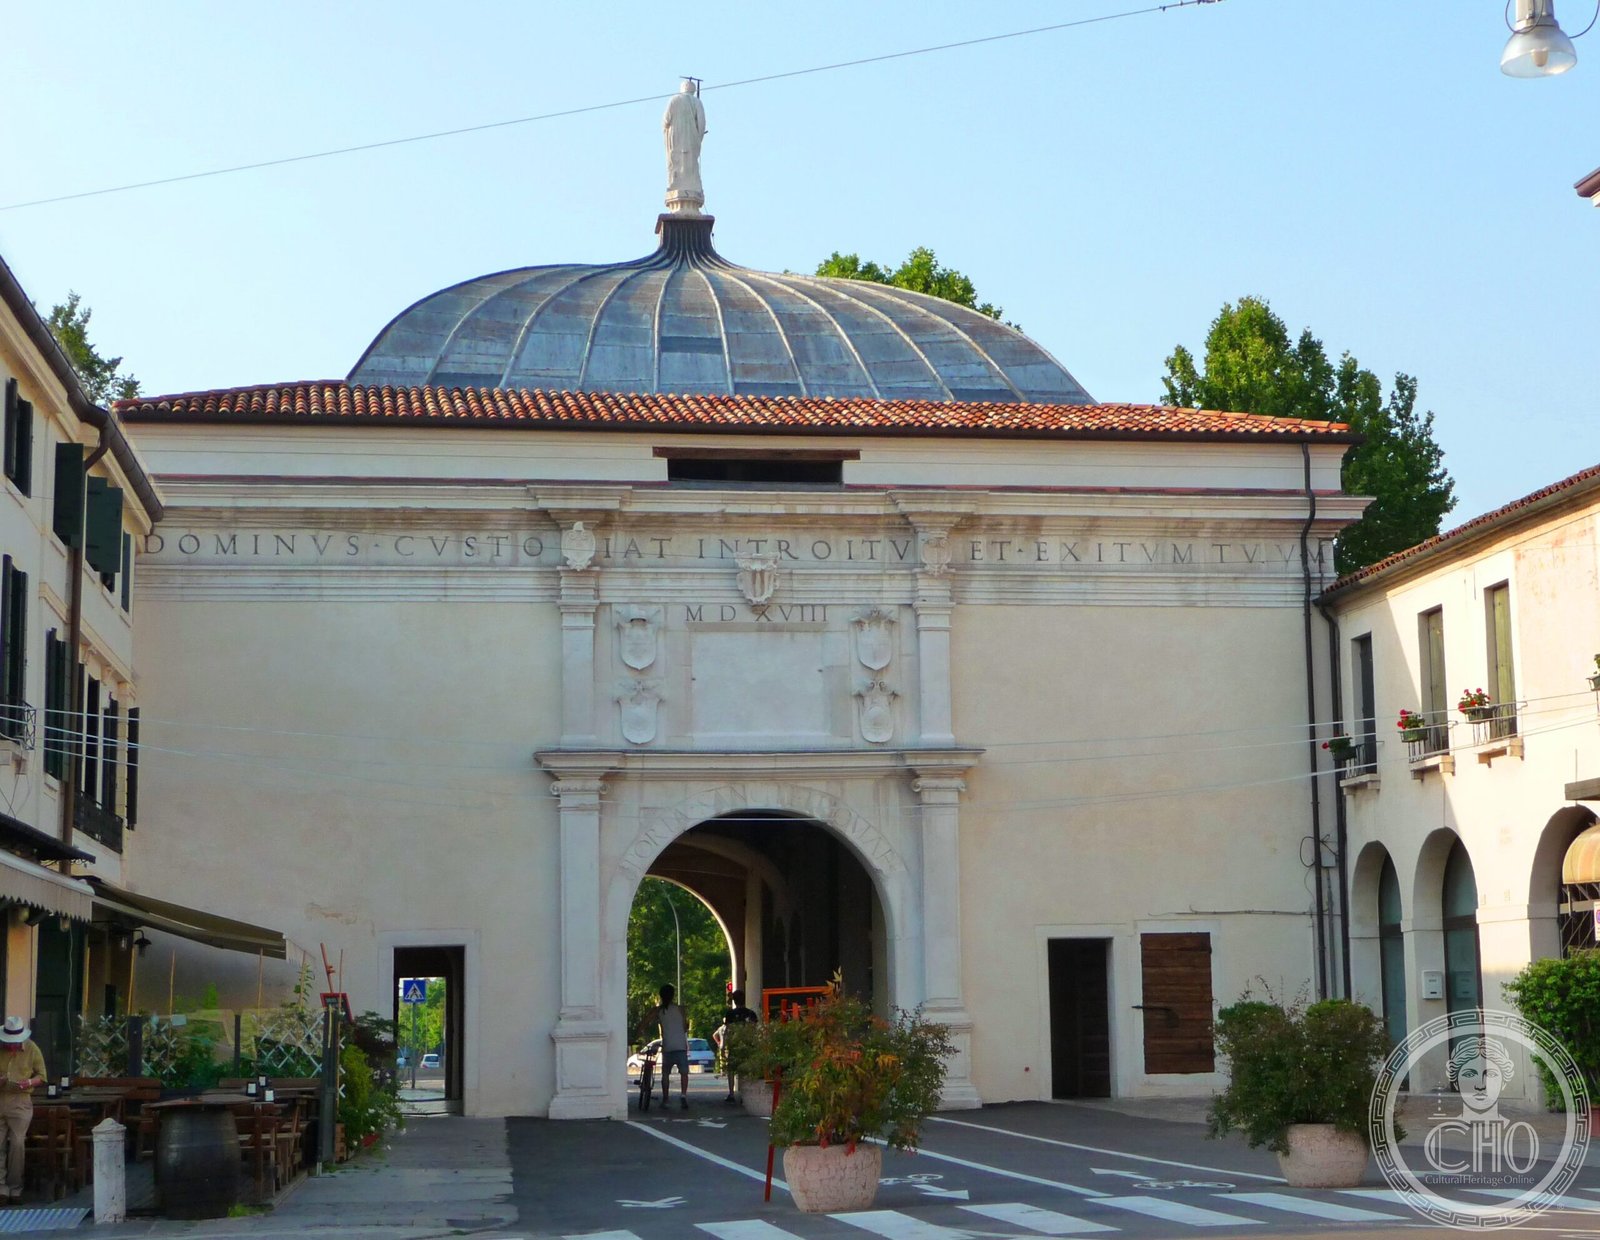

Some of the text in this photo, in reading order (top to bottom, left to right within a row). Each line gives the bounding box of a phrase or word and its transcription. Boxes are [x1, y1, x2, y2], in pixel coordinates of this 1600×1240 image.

[144, 533, 359, 556] DOMINVS
[394, 535, 673, 559] CVSTOIAT
[698, 538, 914, 561] INTROITV
